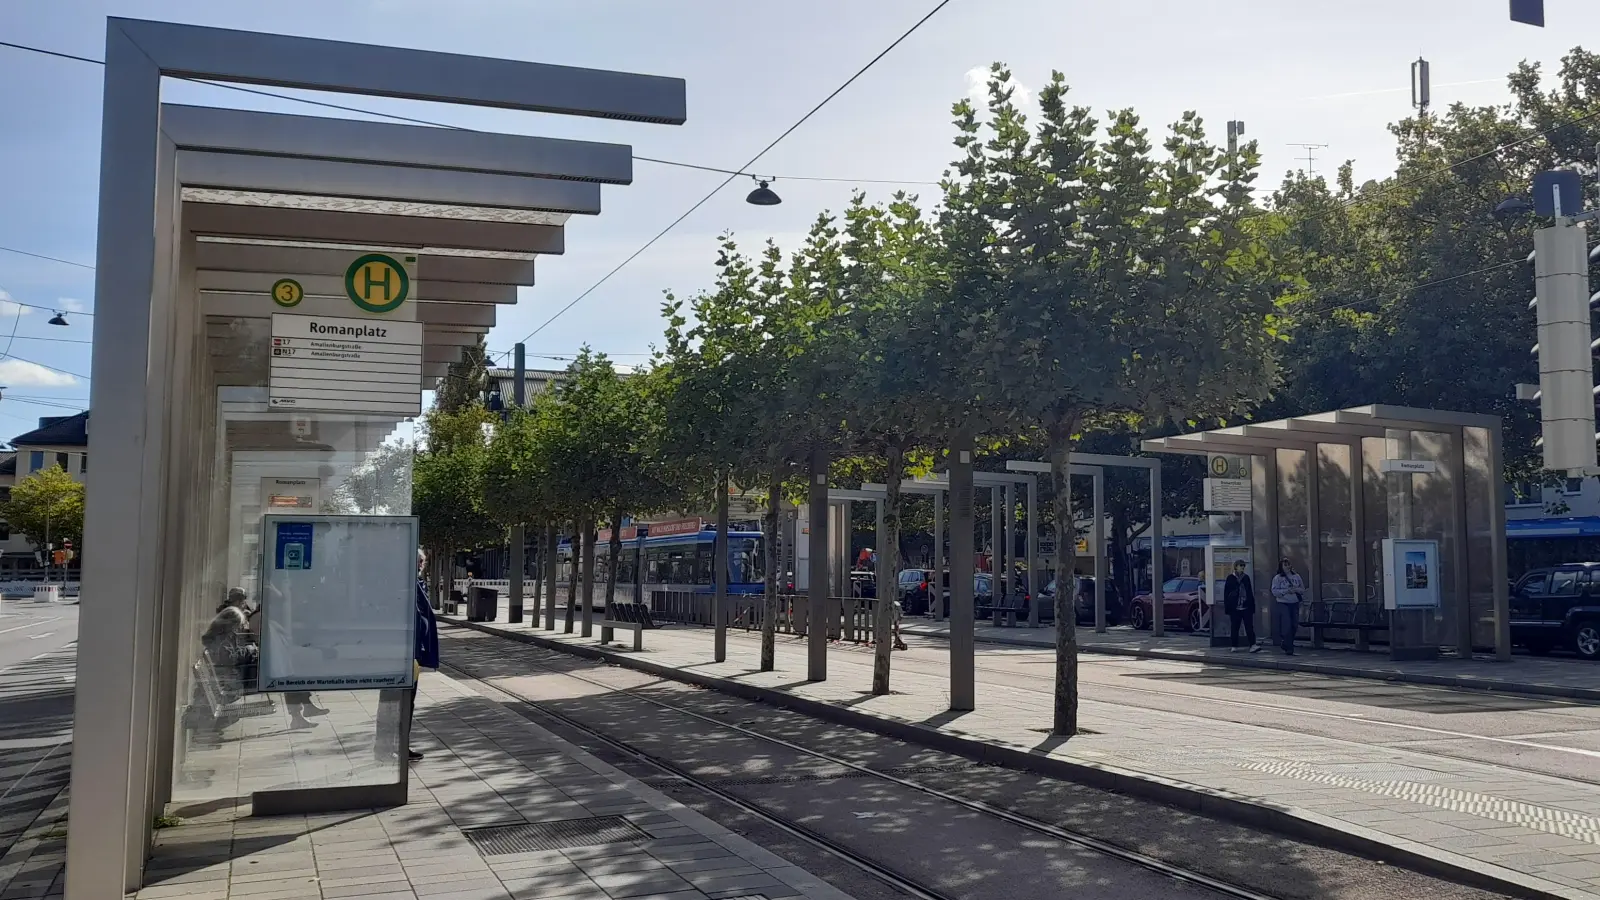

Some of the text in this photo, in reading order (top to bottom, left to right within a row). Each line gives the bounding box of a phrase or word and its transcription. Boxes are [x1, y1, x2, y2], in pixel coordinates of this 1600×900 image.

[365, 266, 390, 300] H
[281, 284, 293, 301] 3
[310, 322, 387, 338] Romanplatz
[310, 341, 362, 350] Amalienburgstraße
[310, 350, 361, 359] Amalienburgstraße
